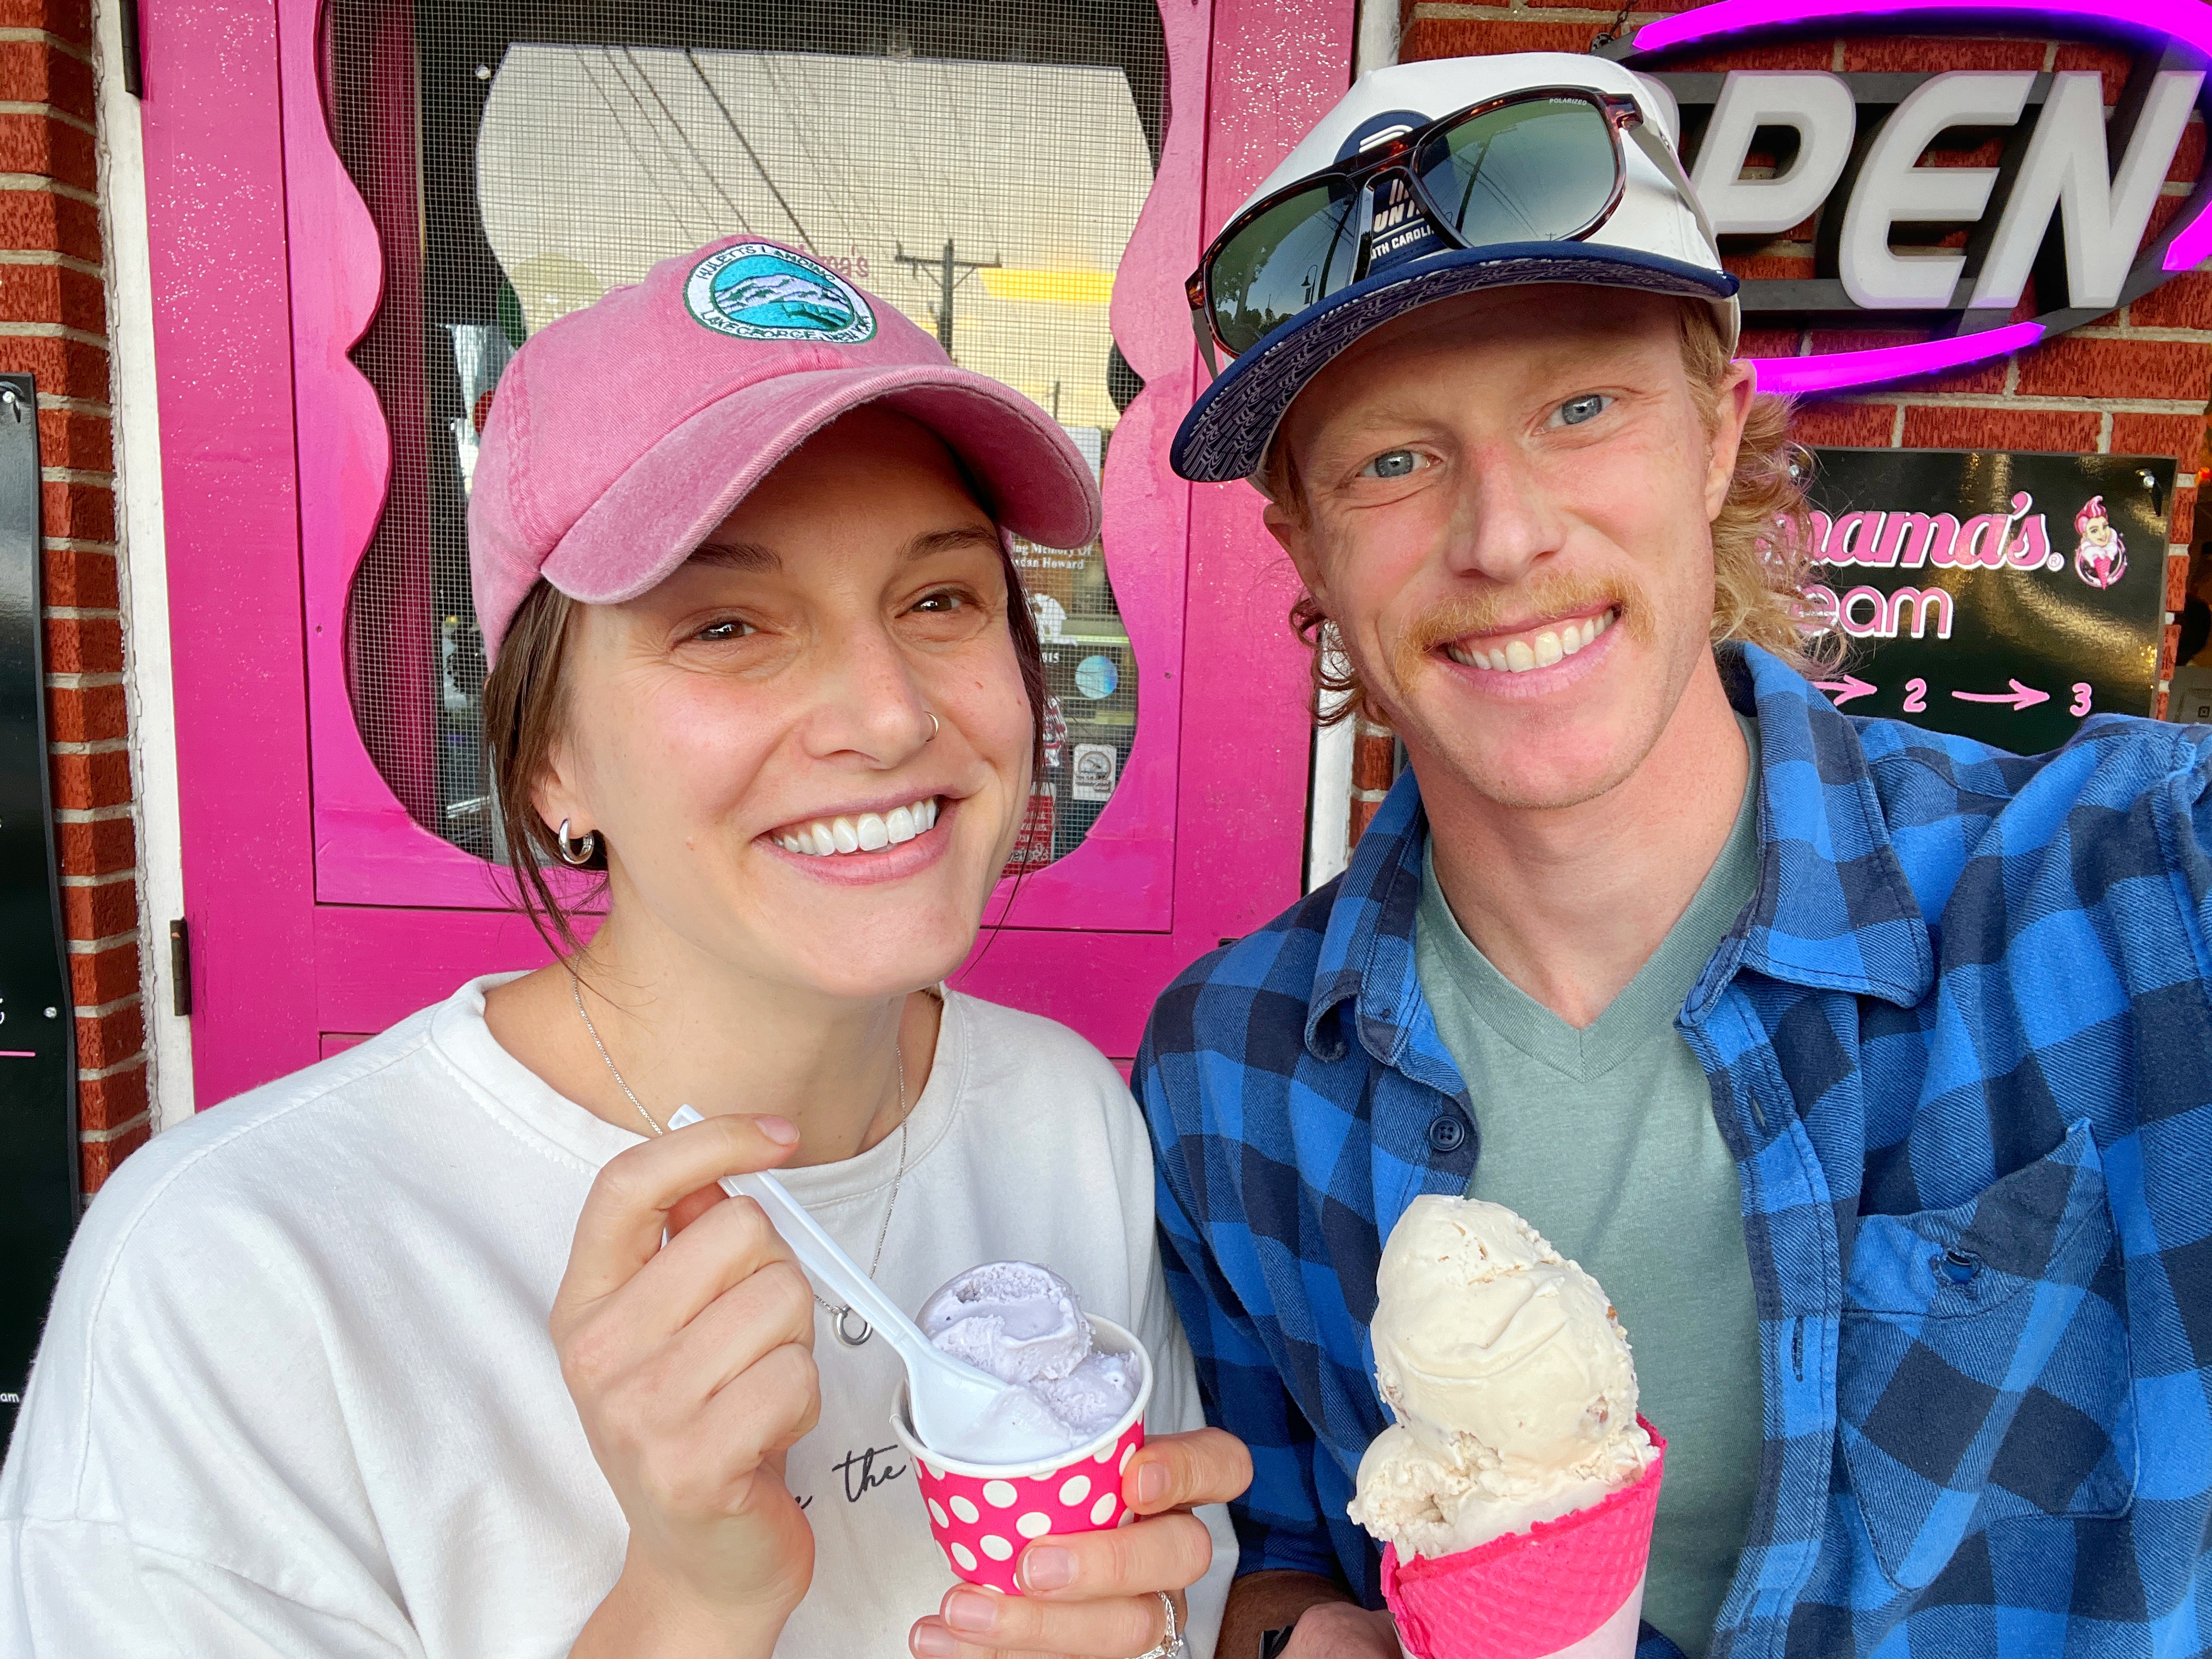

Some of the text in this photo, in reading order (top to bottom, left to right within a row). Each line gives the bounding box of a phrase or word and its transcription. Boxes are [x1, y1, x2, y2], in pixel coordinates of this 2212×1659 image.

[1549, 98, 1587, 106] POLARIZED
[1637, 70, 2206, 309] PEN
[1391, 224, 1435, 250] CAROLI
[1043, 557, 1085, 569] Howard
[1791, 584, 1954, 639] eam
[1042, 652, 1059, 663] 015
[1903, 678, 1927, 713] 2
[2069, 682, 2092, 717] 3
[832, 1444, 907, 1503] the
